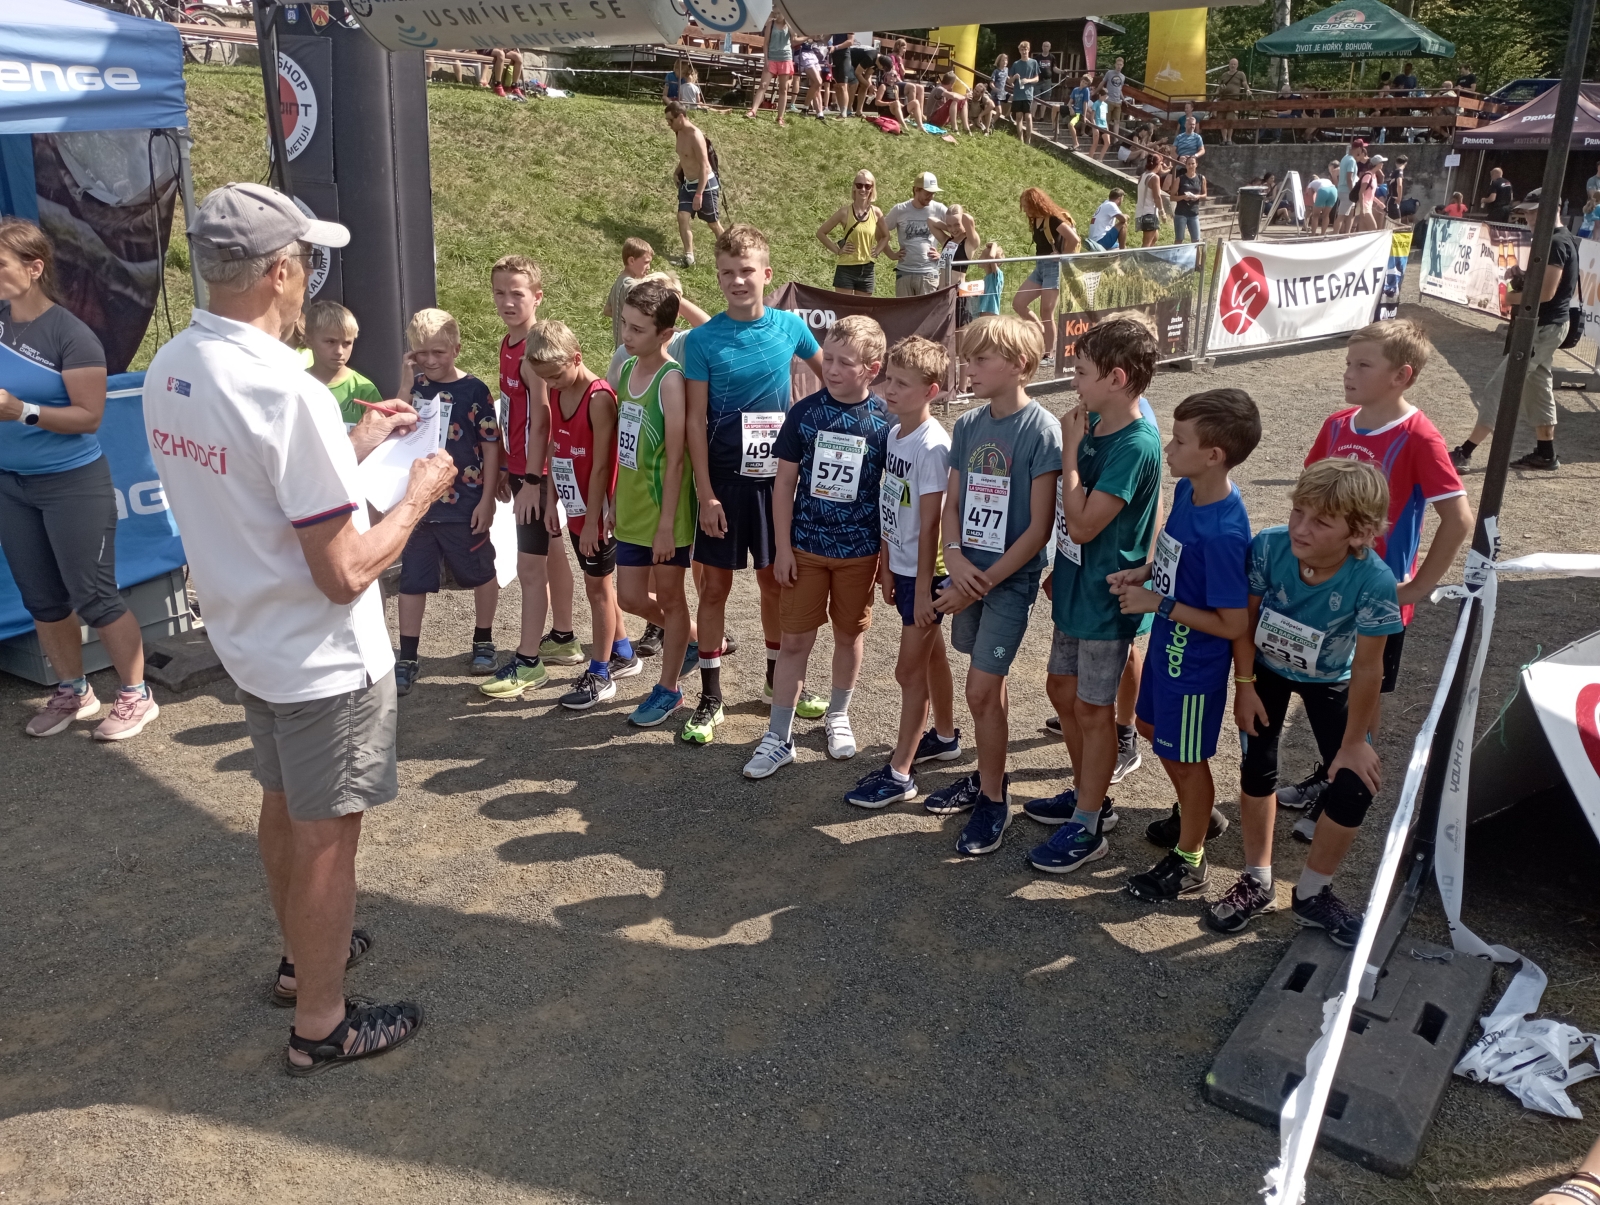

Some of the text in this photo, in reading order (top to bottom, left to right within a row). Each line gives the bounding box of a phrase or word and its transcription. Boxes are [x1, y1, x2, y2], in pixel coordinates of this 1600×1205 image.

[594, 0, 626, 20] SE
[470, 30, 598, 48] NA ANTÉNY
[1295, 43, 1312, 52] ŽIVOT
[1313, 43, 1321, 52] JE
[1462, 137, 1494, 145] PRIMATOR
[1454, 260, 1470, 276] CUP
[1277, 267, 1383, 308] INTEGRAF
[22, 343, 41, 355] SPORT
[817, 462, 854, 483] 575
[557, 484, 575, 500] 567
[882, 504, 897, 528] 591
[968, 507, 1003, 529] 477
[1281, 620, 1303, 632] redpoint
[1262, 622, 1316, 649] BUFO BABY CROSS
